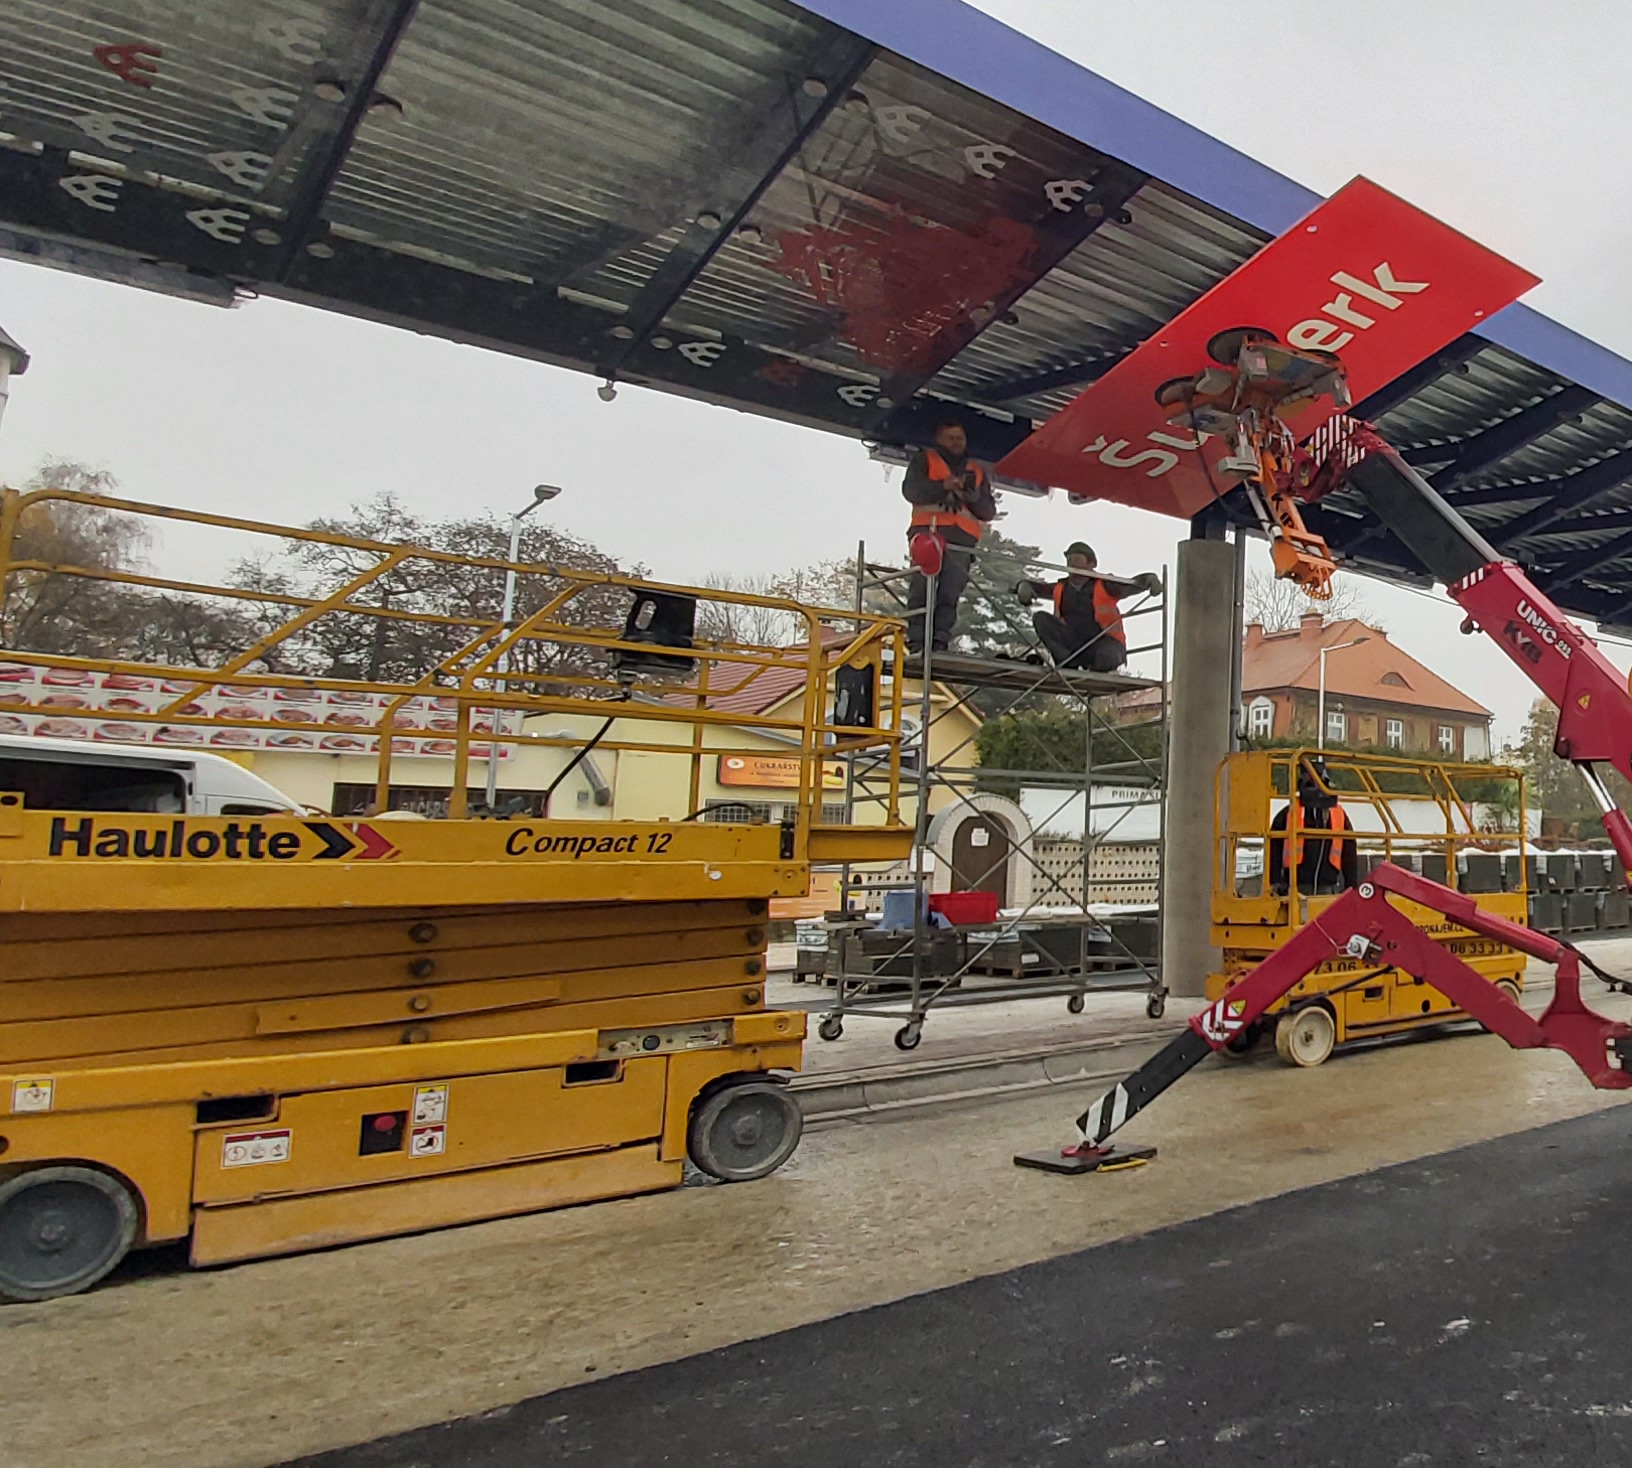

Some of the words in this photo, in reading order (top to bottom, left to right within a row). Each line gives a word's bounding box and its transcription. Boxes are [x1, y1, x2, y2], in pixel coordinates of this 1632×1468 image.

[1082, 261, 1431, 478] Šuerk
[1515, 600, 1557, 645] UNIC
[49, 817, 301, 859] Haulotte
[506, 827, 639, 859] Compact
[647, 833, 673, 854] 12
